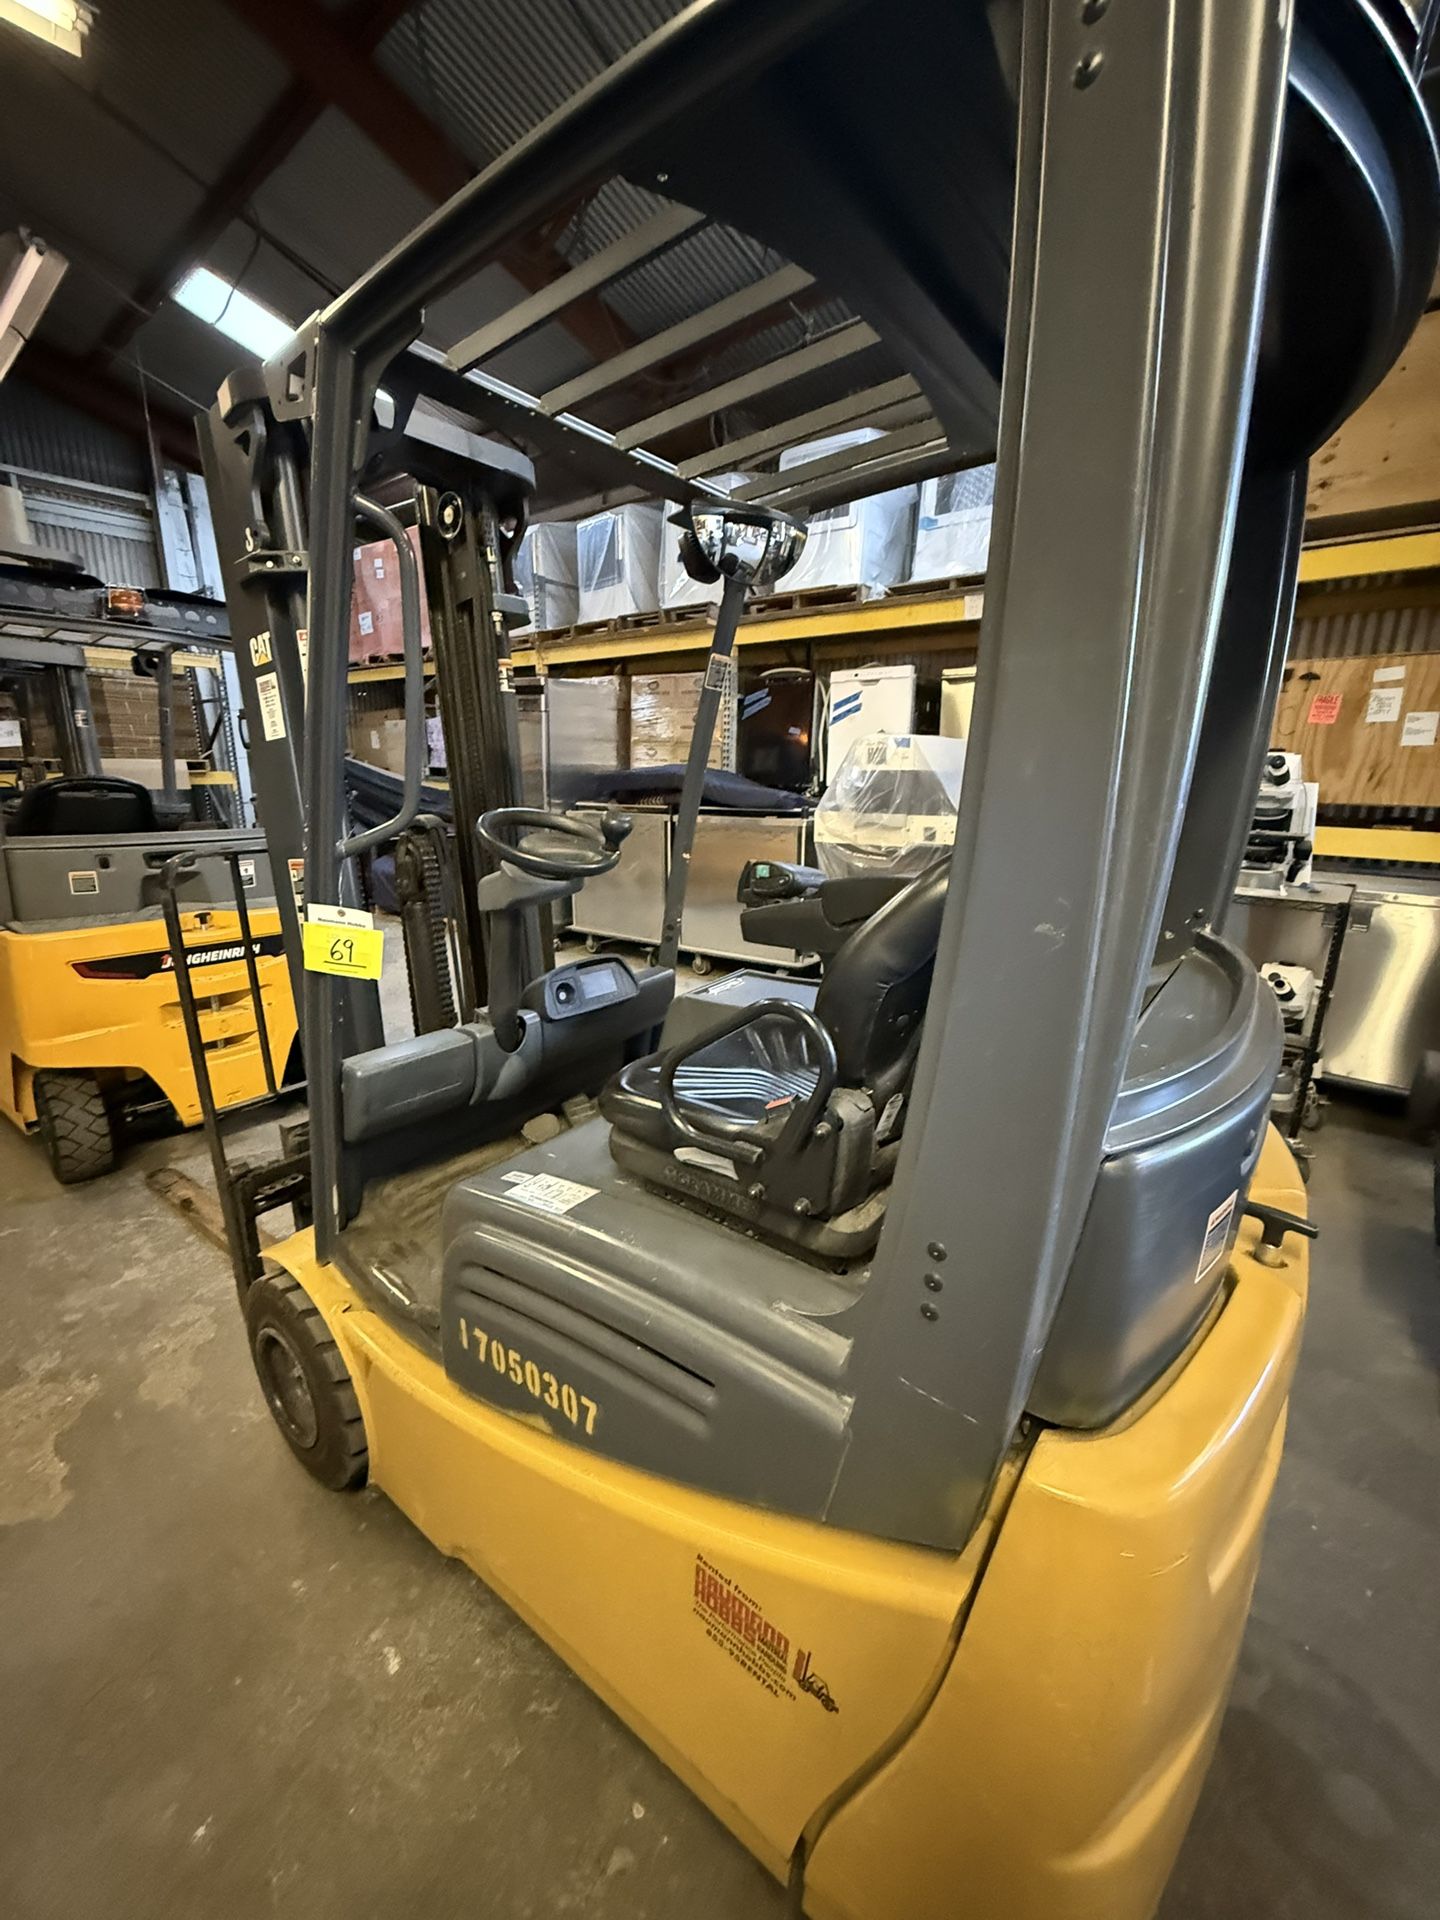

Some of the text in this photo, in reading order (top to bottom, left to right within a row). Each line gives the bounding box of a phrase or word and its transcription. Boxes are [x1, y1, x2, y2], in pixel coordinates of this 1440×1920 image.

[249, 630, 273, 667] CAT
[330, 938, 354, 963] 69
[459, 1317, 598, 1435] 17050307
[696, 1553, 732, 1587] Rented
